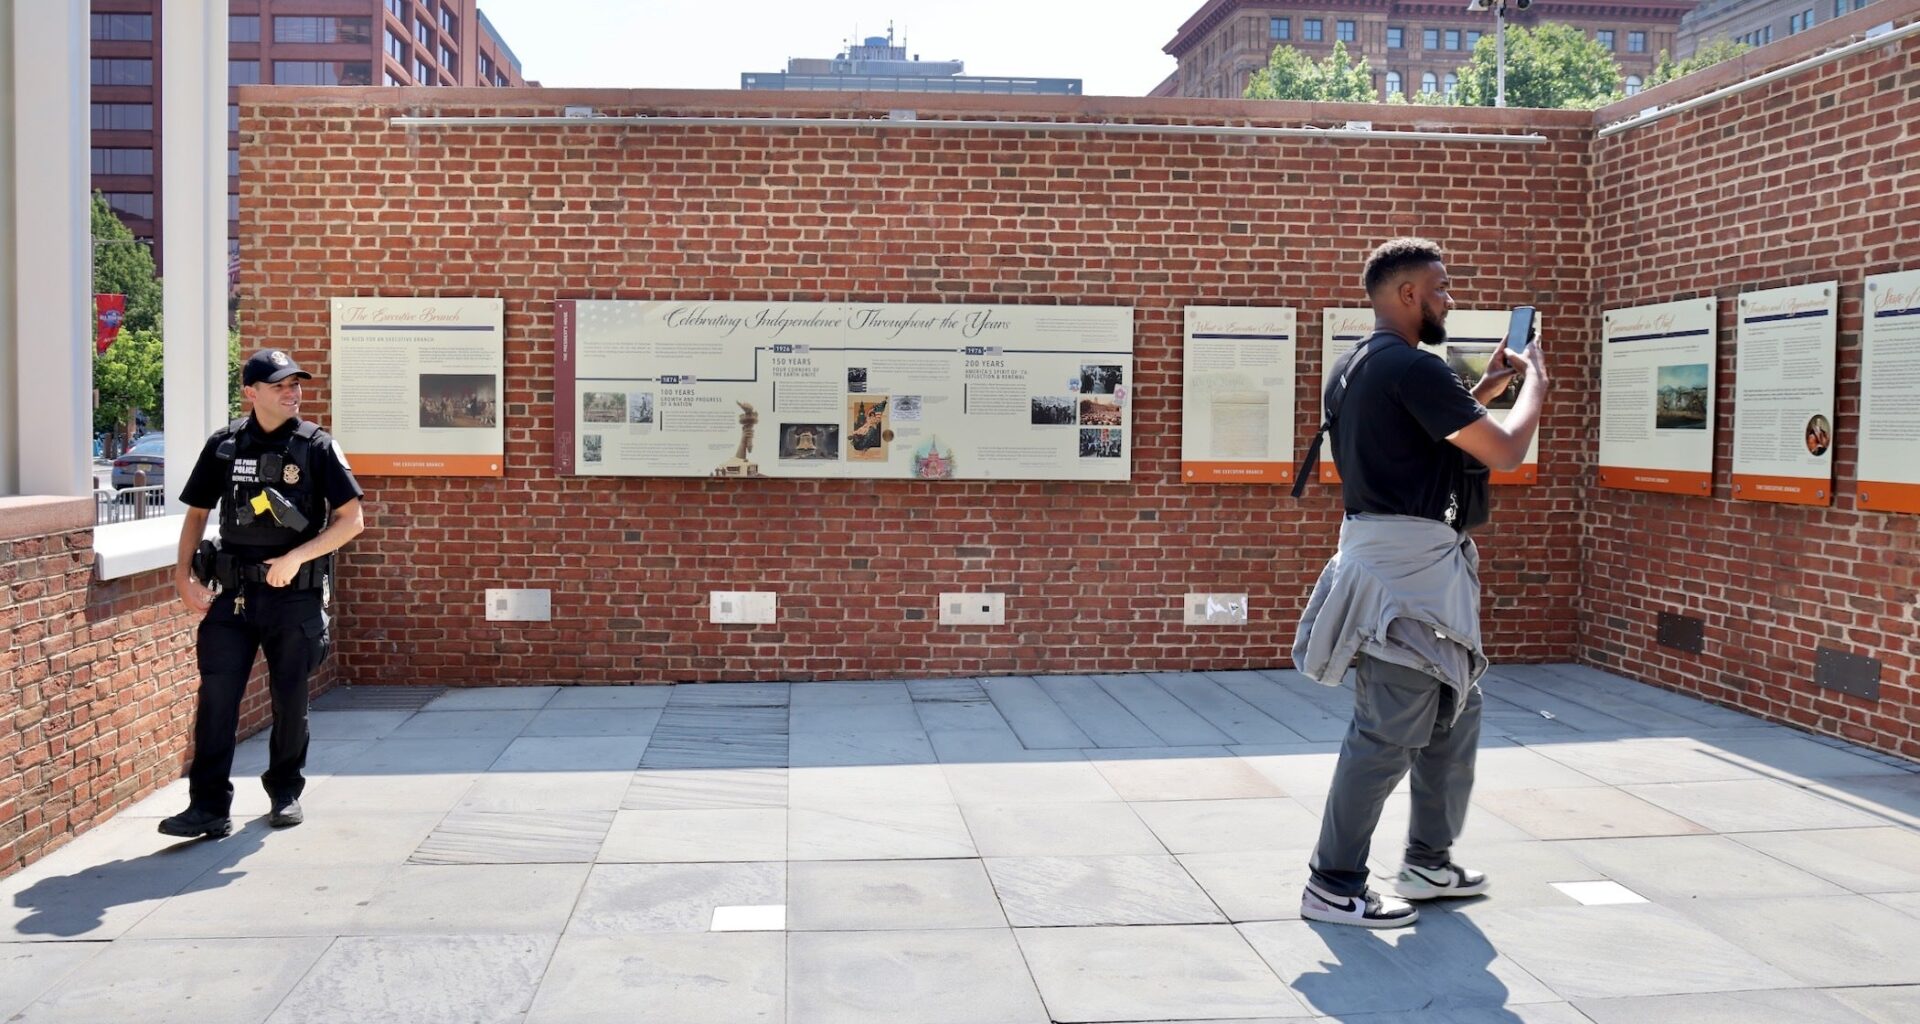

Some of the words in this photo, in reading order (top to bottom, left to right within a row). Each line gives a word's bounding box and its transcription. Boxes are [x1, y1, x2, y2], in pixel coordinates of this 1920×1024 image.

[340, 306, 367, 323] The
[371, 307, 416, 322] Executive
[419, 306, 465, 323] Branch
[663, 306, 742, 338] Celebrating
[744, 307, 841, 338] Independence
[847, 308, 940, 340] Throughout
[940, 309, 960, 329] the
[962, 308, 1012, 339] Years
[233, 466, 257, 475] POLICE
